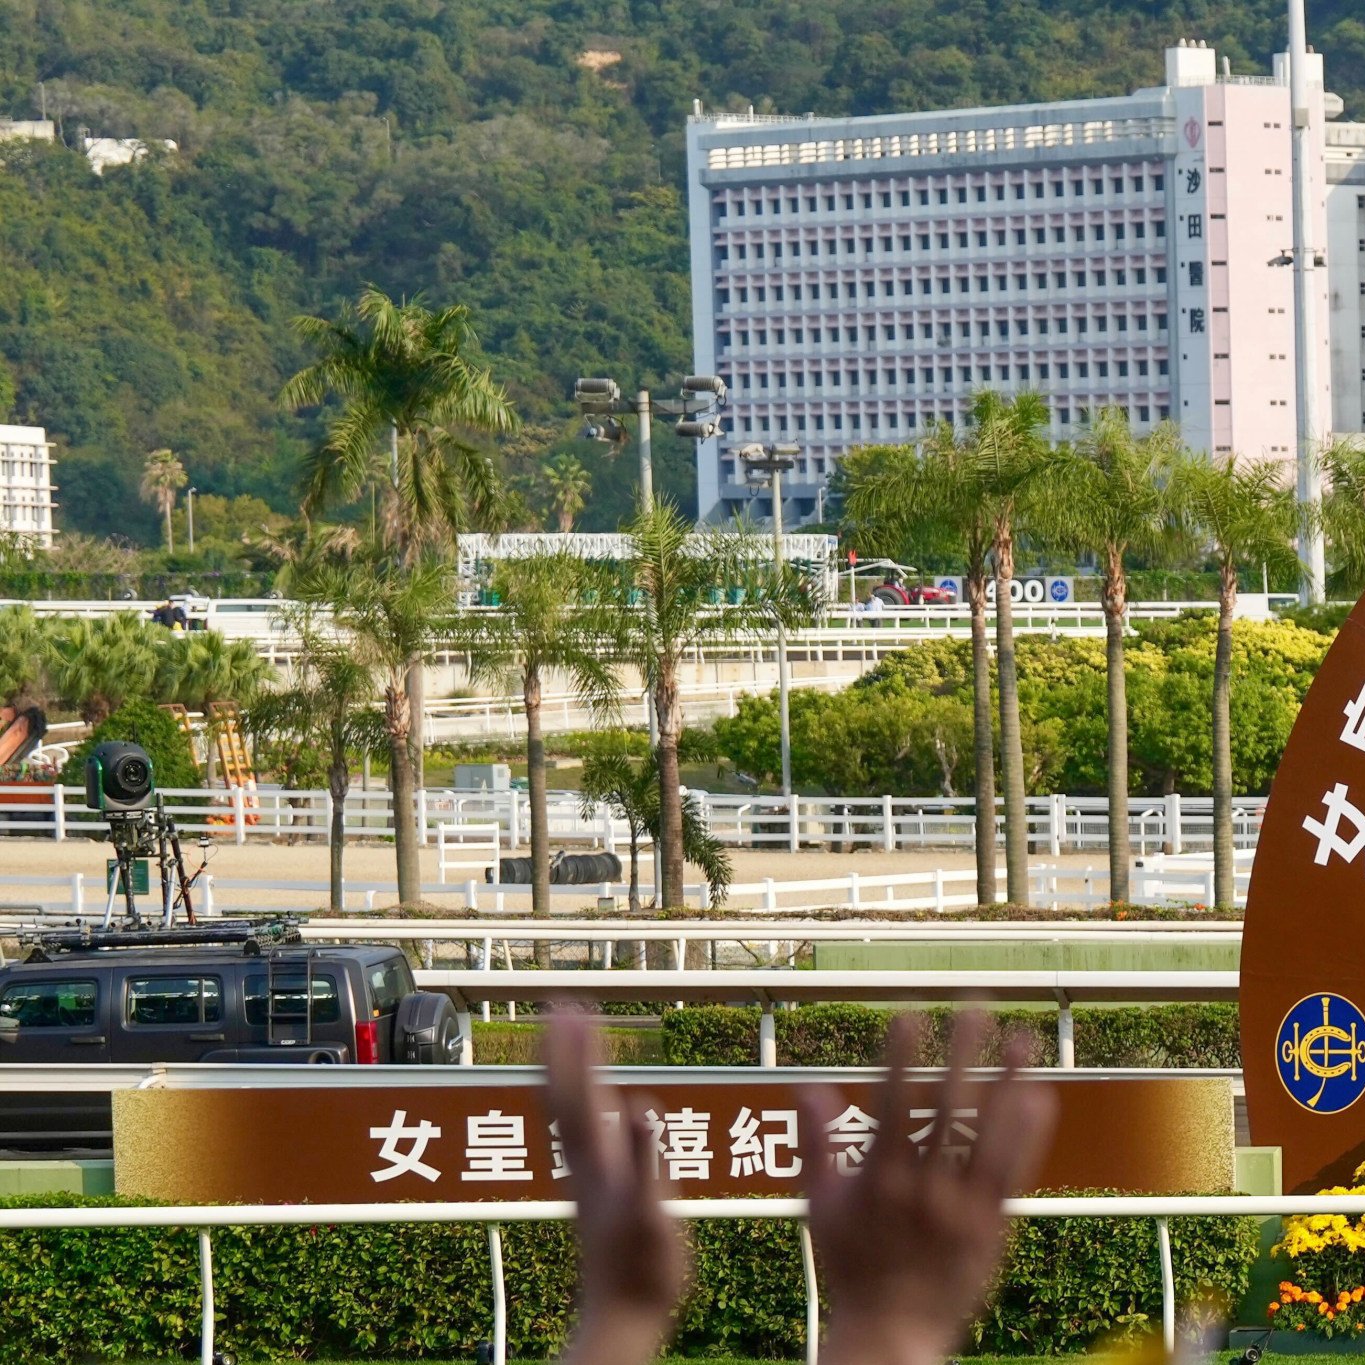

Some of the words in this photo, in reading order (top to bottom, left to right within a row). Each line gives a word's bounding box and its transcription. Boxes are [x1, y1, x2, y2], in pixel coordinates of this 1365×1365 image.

[369, 1106, 980, 1183] 女皇禧紀念
